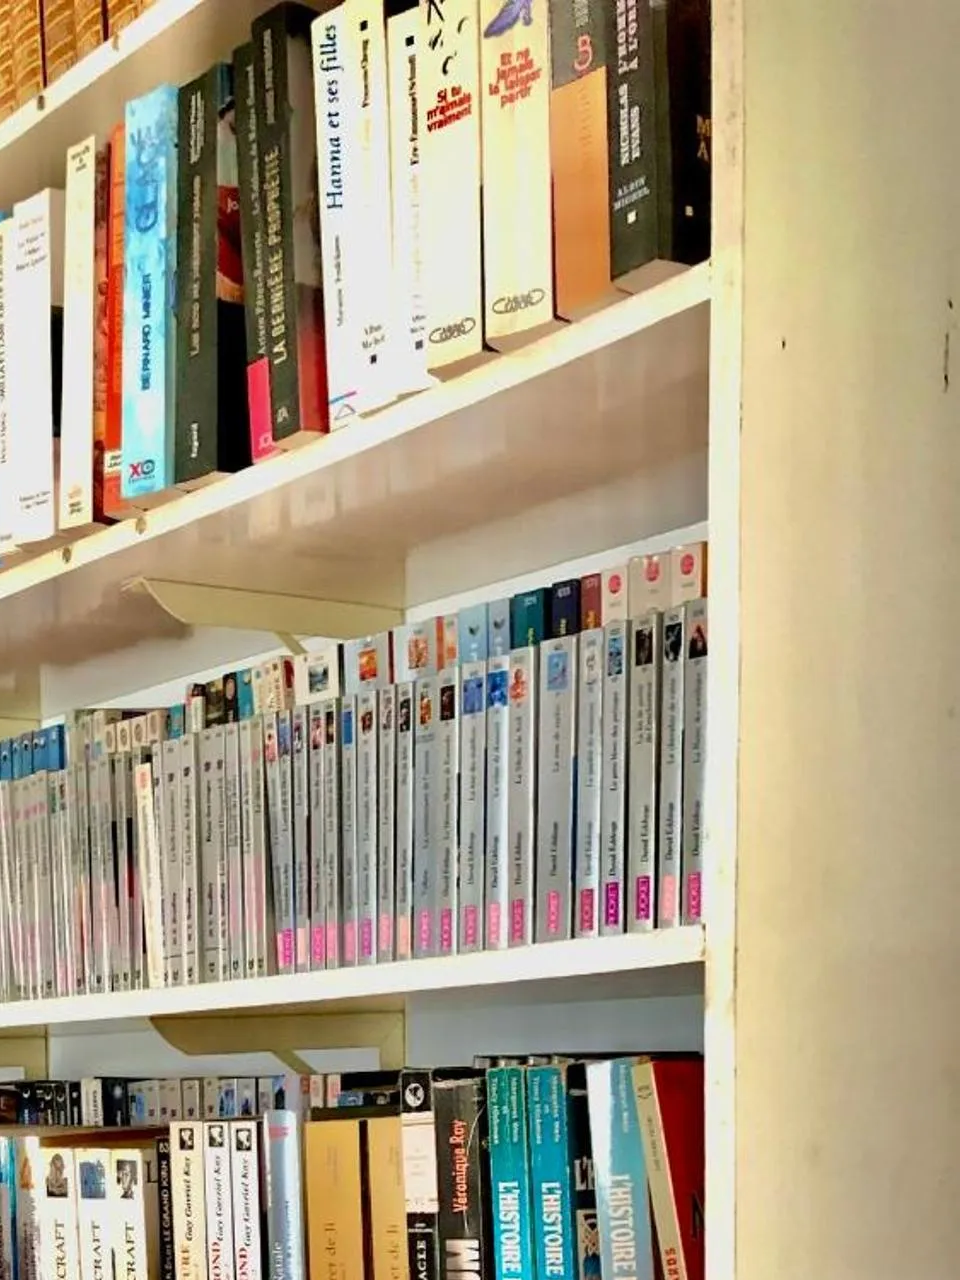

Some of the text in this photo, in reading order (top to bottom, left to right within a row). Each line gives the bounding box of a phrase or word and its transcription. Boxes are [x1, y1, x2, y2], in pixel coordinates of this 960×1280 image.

[320, 24, 344, 209] Hanna et ses filles
[427, 104, 473, 133] vraiment
[139, 272, 153, 390] BERNARD MINIER
[273, 338, 288, 364] LA
[183, 1179, 194, 1218] Gavriel
[449, 1118, 471, 1214] Véronique Roy
[184, 1220, 195, 1242] Guy
[323, 1237, 337, 1257] de
[387, 1239, 401, 1260] de
[497, 1180, 521, 1273] L'HISTOIRE
[540, 1180, 565, 1276] L'HISTOIRE
[608, 1172, 633, 1272] L'HISTOIRE
